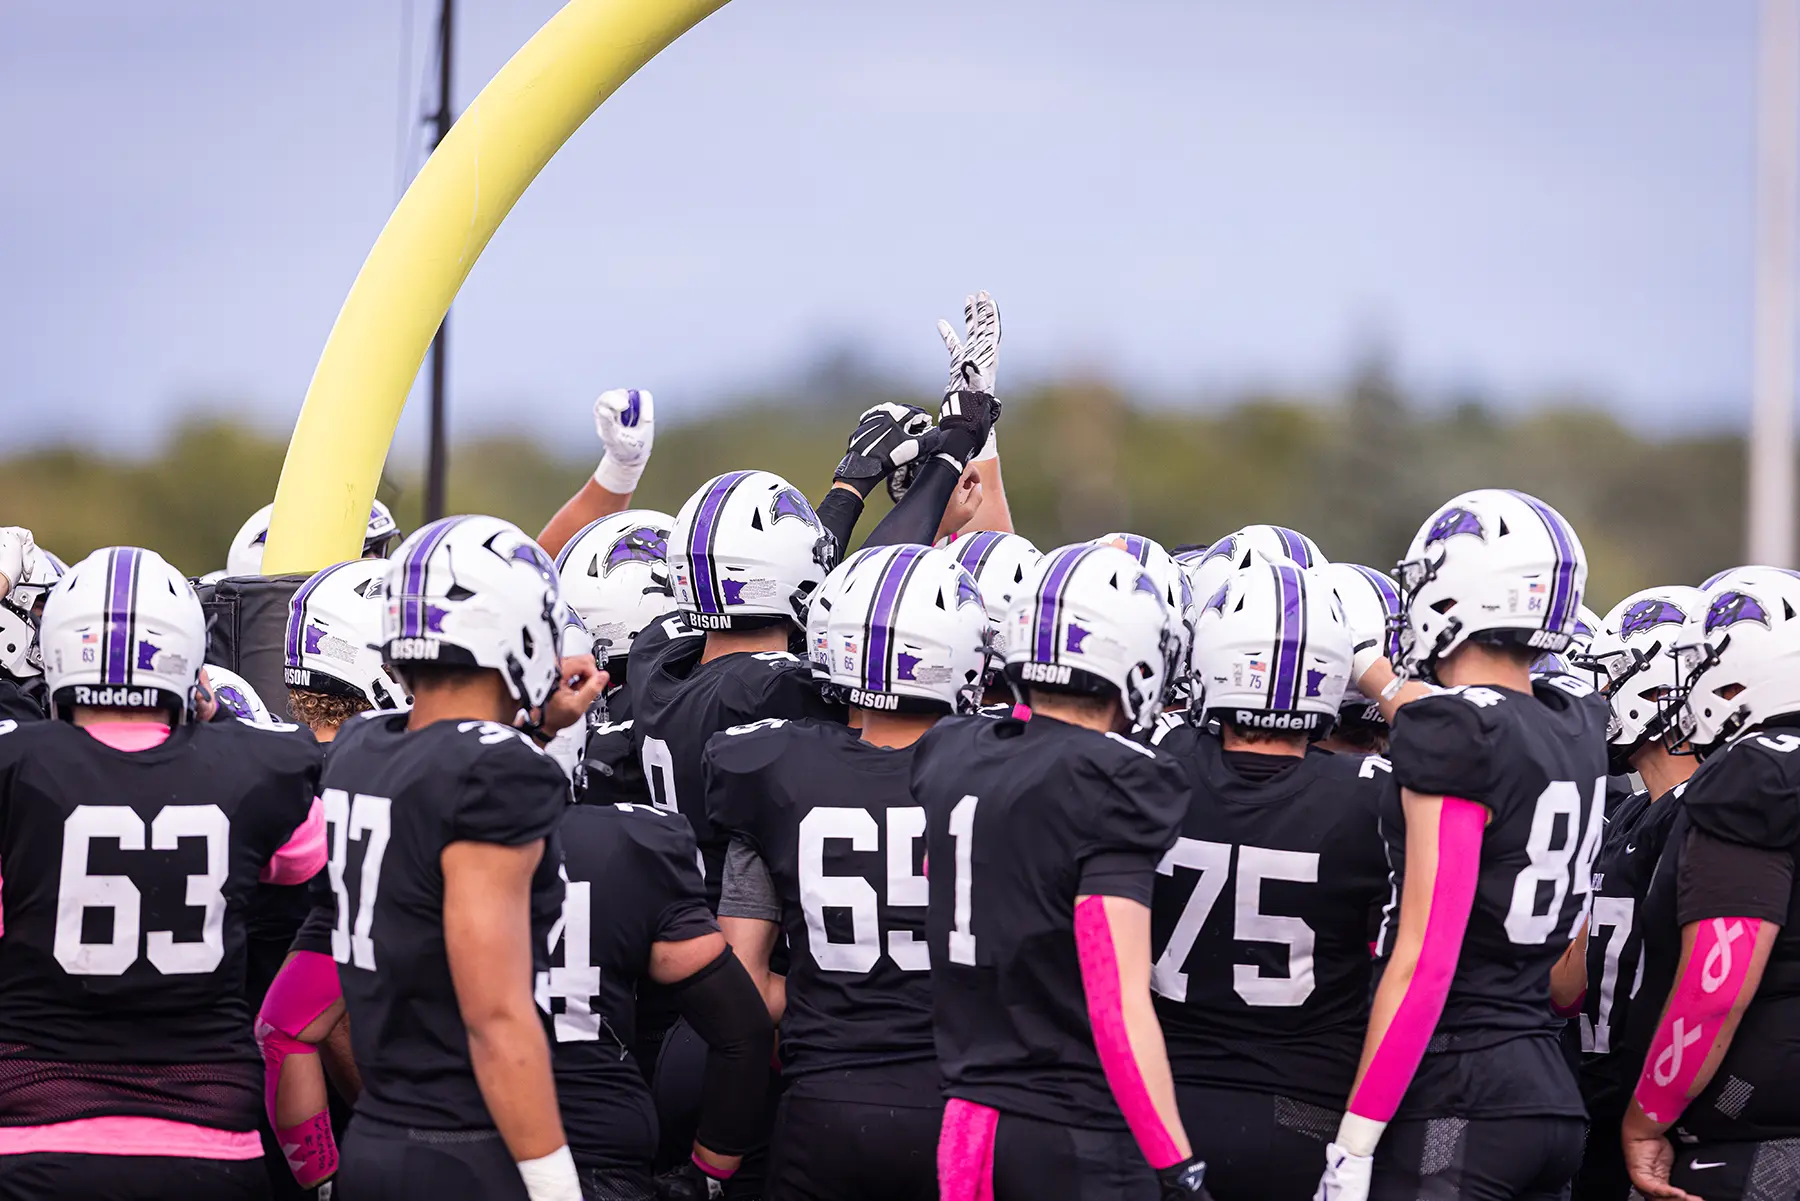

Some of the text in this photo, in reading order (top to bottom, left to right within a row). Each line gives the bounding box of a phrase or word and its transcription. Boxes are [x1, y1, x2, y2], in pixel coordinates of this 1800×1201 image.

[690, 613, 732, 629] BISON
[83, 648, 95, 663] 63
[391, 638, 440, 660] BISON
[844, 656, 854, 671] 65
[1021, 661, 1072, 685] BISON
[1250, 674, 1262, 689] 75
[75, 686, 159, 707] Riddell
[850, 688, 899, 710] BISON
[1236, 710, 1318, 730] Riddell
[53, 804, 231, 975] 63
[799, 806, 931, 973] 65
[948, 794, 978, 967] 1
[1150, 836, 1320, 1007] 75
